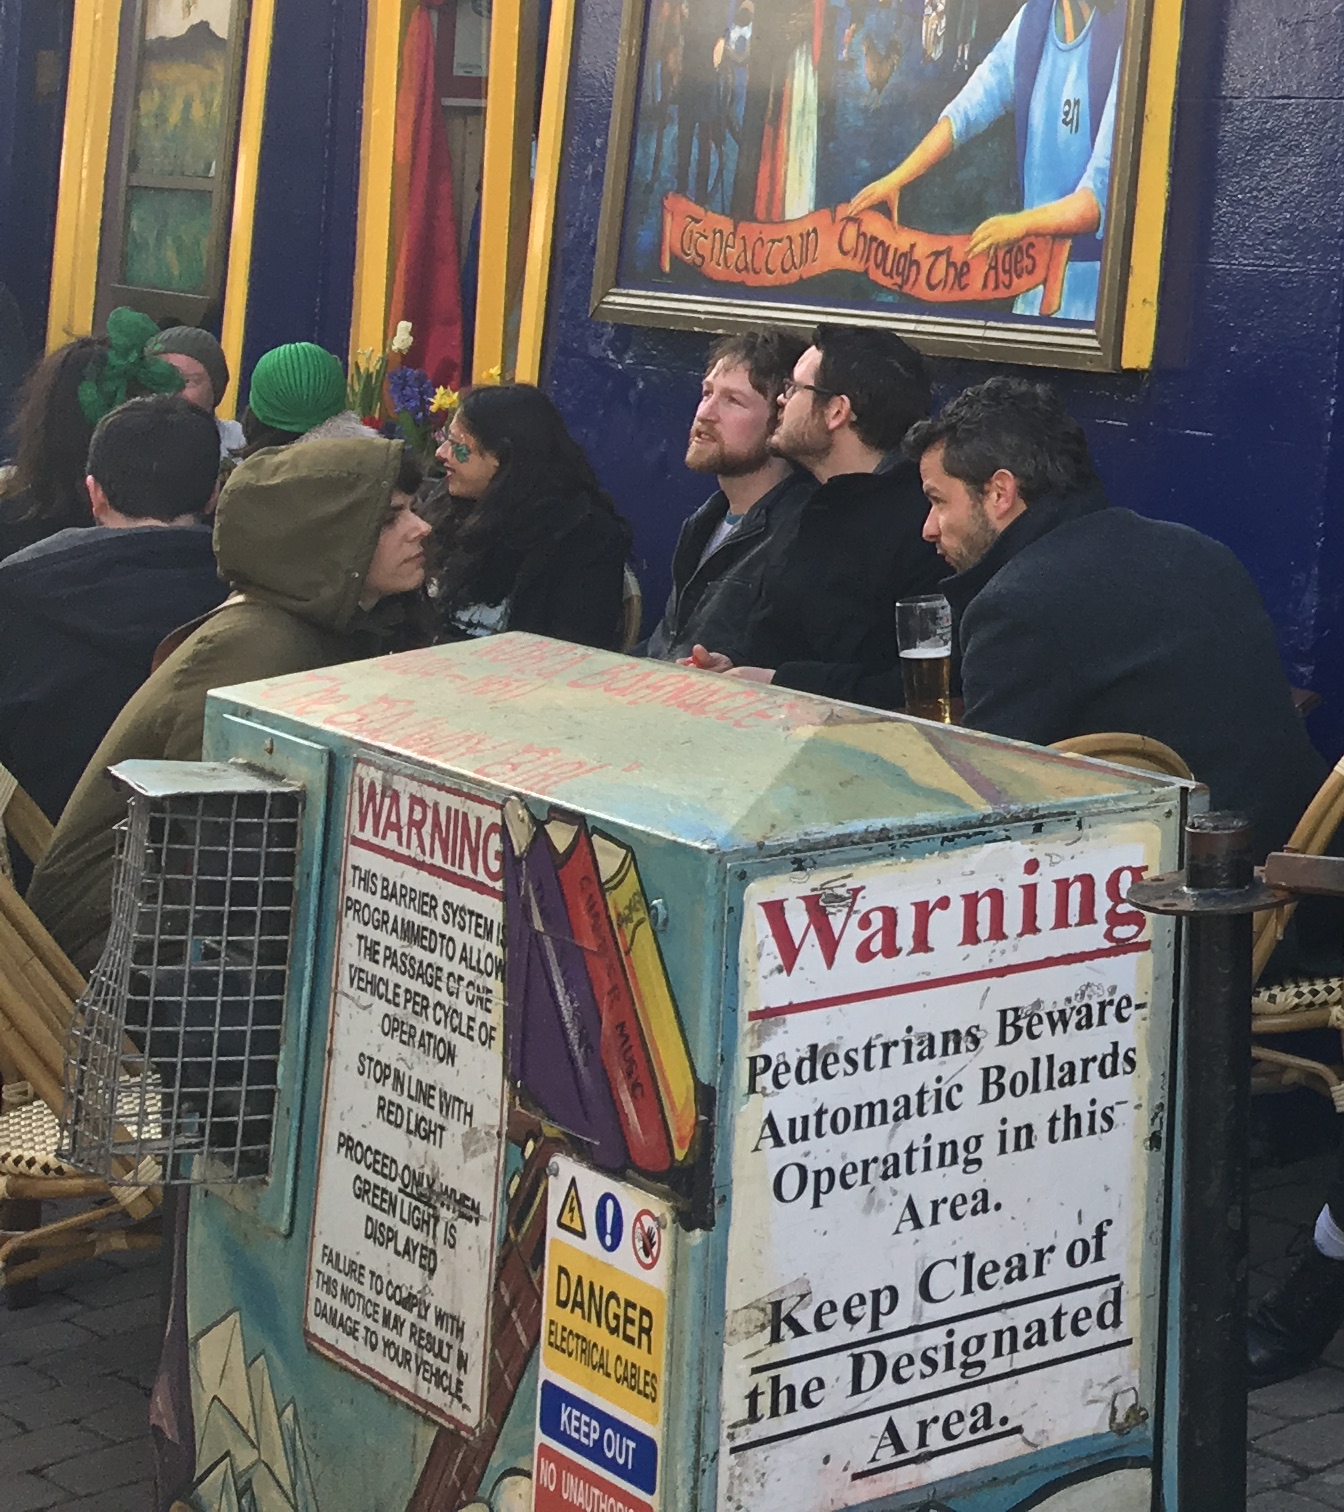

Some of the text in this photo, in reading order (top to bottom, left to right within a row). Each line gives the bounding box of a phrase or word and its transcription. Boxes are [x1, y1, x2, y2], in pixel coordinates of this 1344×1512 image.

[837, 215, 921, 291] Through
[925, 245, 971, 292] The
[981, 241, 1037, 292] Ages
[358, 775, 504, 882] WARNING
[344, 895, 438, 954] PROGRAMMED
[458, 941, 506, 981] ALLOW
[351, 864, 377, 897] THIS
[380, 876, 438, 921] BARRIER
[441, 899, 494, 943] SYSTEM
[758, 858, 1149, 977] Warning
[348, 963, 497, 1050] VEHICLE PER CYCLE OF
[356, 933, 493, 1014] THE PASSAGE OF ONE
[381, 1012, 457, 1067] OPERATION
[746, 1022, 982, 1097] Pedestrians
[357, 1051, 474, 1128] STOP IN LINE WITH
[376, 1094, 446, 1149] RED LIGHT
[751, 1041, 1138, 1154] Automatic Bollards
[336, 1130, 399, 1183] PROCEED
[771, 1132, 984, 1207] Operating
[996, 1117, 1036, 1158] in
[352, 1173, 458, 1249] GREEN LIGHT IS
[364, 1214, 438, 1277] DISPLAYED
[891, 1185, 1003, 1236] Area.
[315, 1269, 469, 1375] THIS NOTICE MAY RESULT IN
[321, 1243, 466, 1344] FAILURE TO COMPLY WITH
[555, 1264, 654, 1356] DANGER
[764, 1218, 1114, 1348] Keep Clear of
[314, 1296, 361, 1342] DAMAGE
[363, 1325, 379, 1352] TO
[381, 1334, 413, 1374] YOUR
[547, 1318, 658, 1404] ELECTRICAL CABLES
[742, 1284, 1125, 1426] the Designated
[559, 1402, 637, 1470] KEEP OUT
[866, 1395, 1010, 1465] Area.
[539, 1456, 635, 1512] NO UNAUTH
